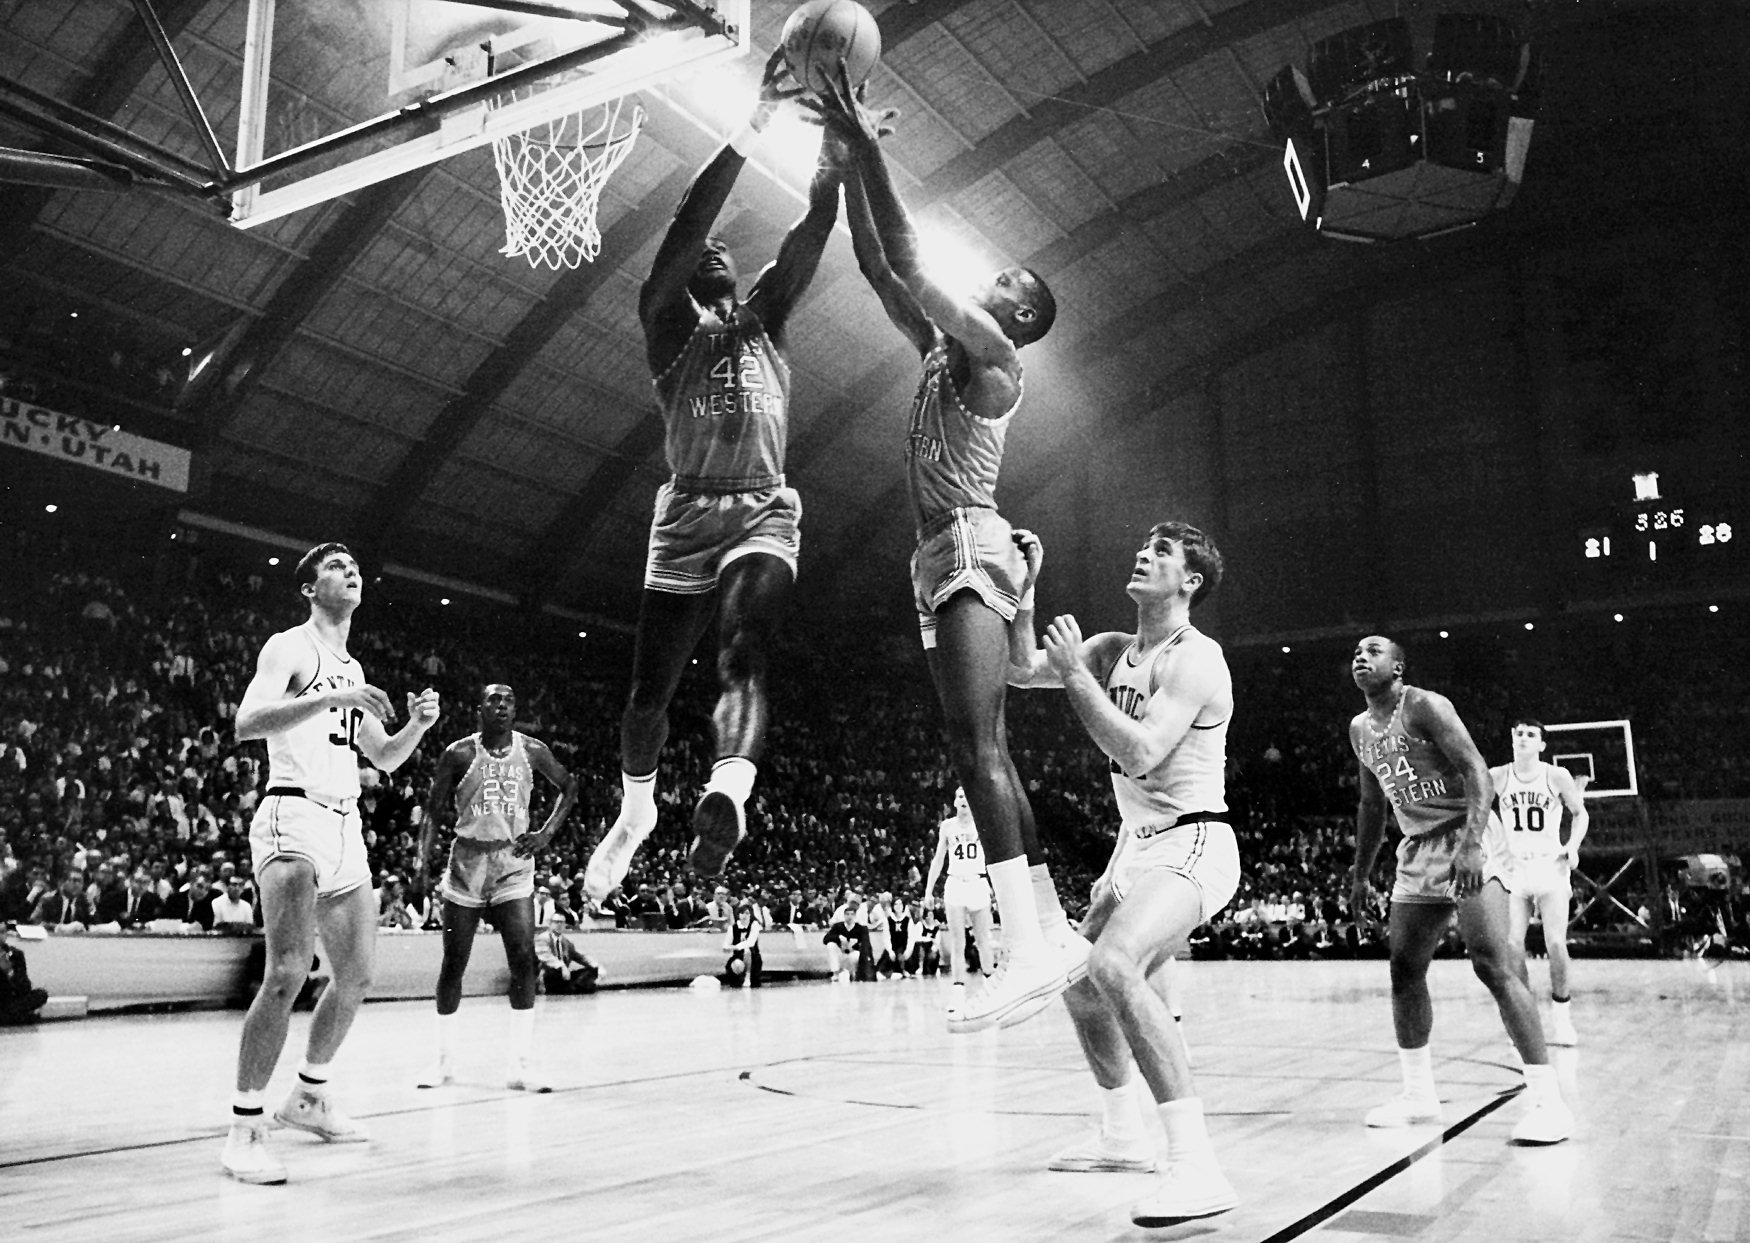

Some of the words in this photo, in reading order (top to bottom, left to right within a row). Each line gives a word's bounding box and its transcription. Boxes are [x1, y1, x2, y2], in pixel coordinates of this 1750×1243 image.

[1476, 152, 1484, 164] 5
[710, 355, 764, 388] 42
[61, 435, 161, 480] UTAH
[480, 763, 525, 781] TEXAS
[1376, 756, 1418, 791] 24
[483, 779, 519, 802] 23
[1512, 806, 1545, 832] 10
[954, 843, 977, 860] 40
[895, 922, 902, 932] K
